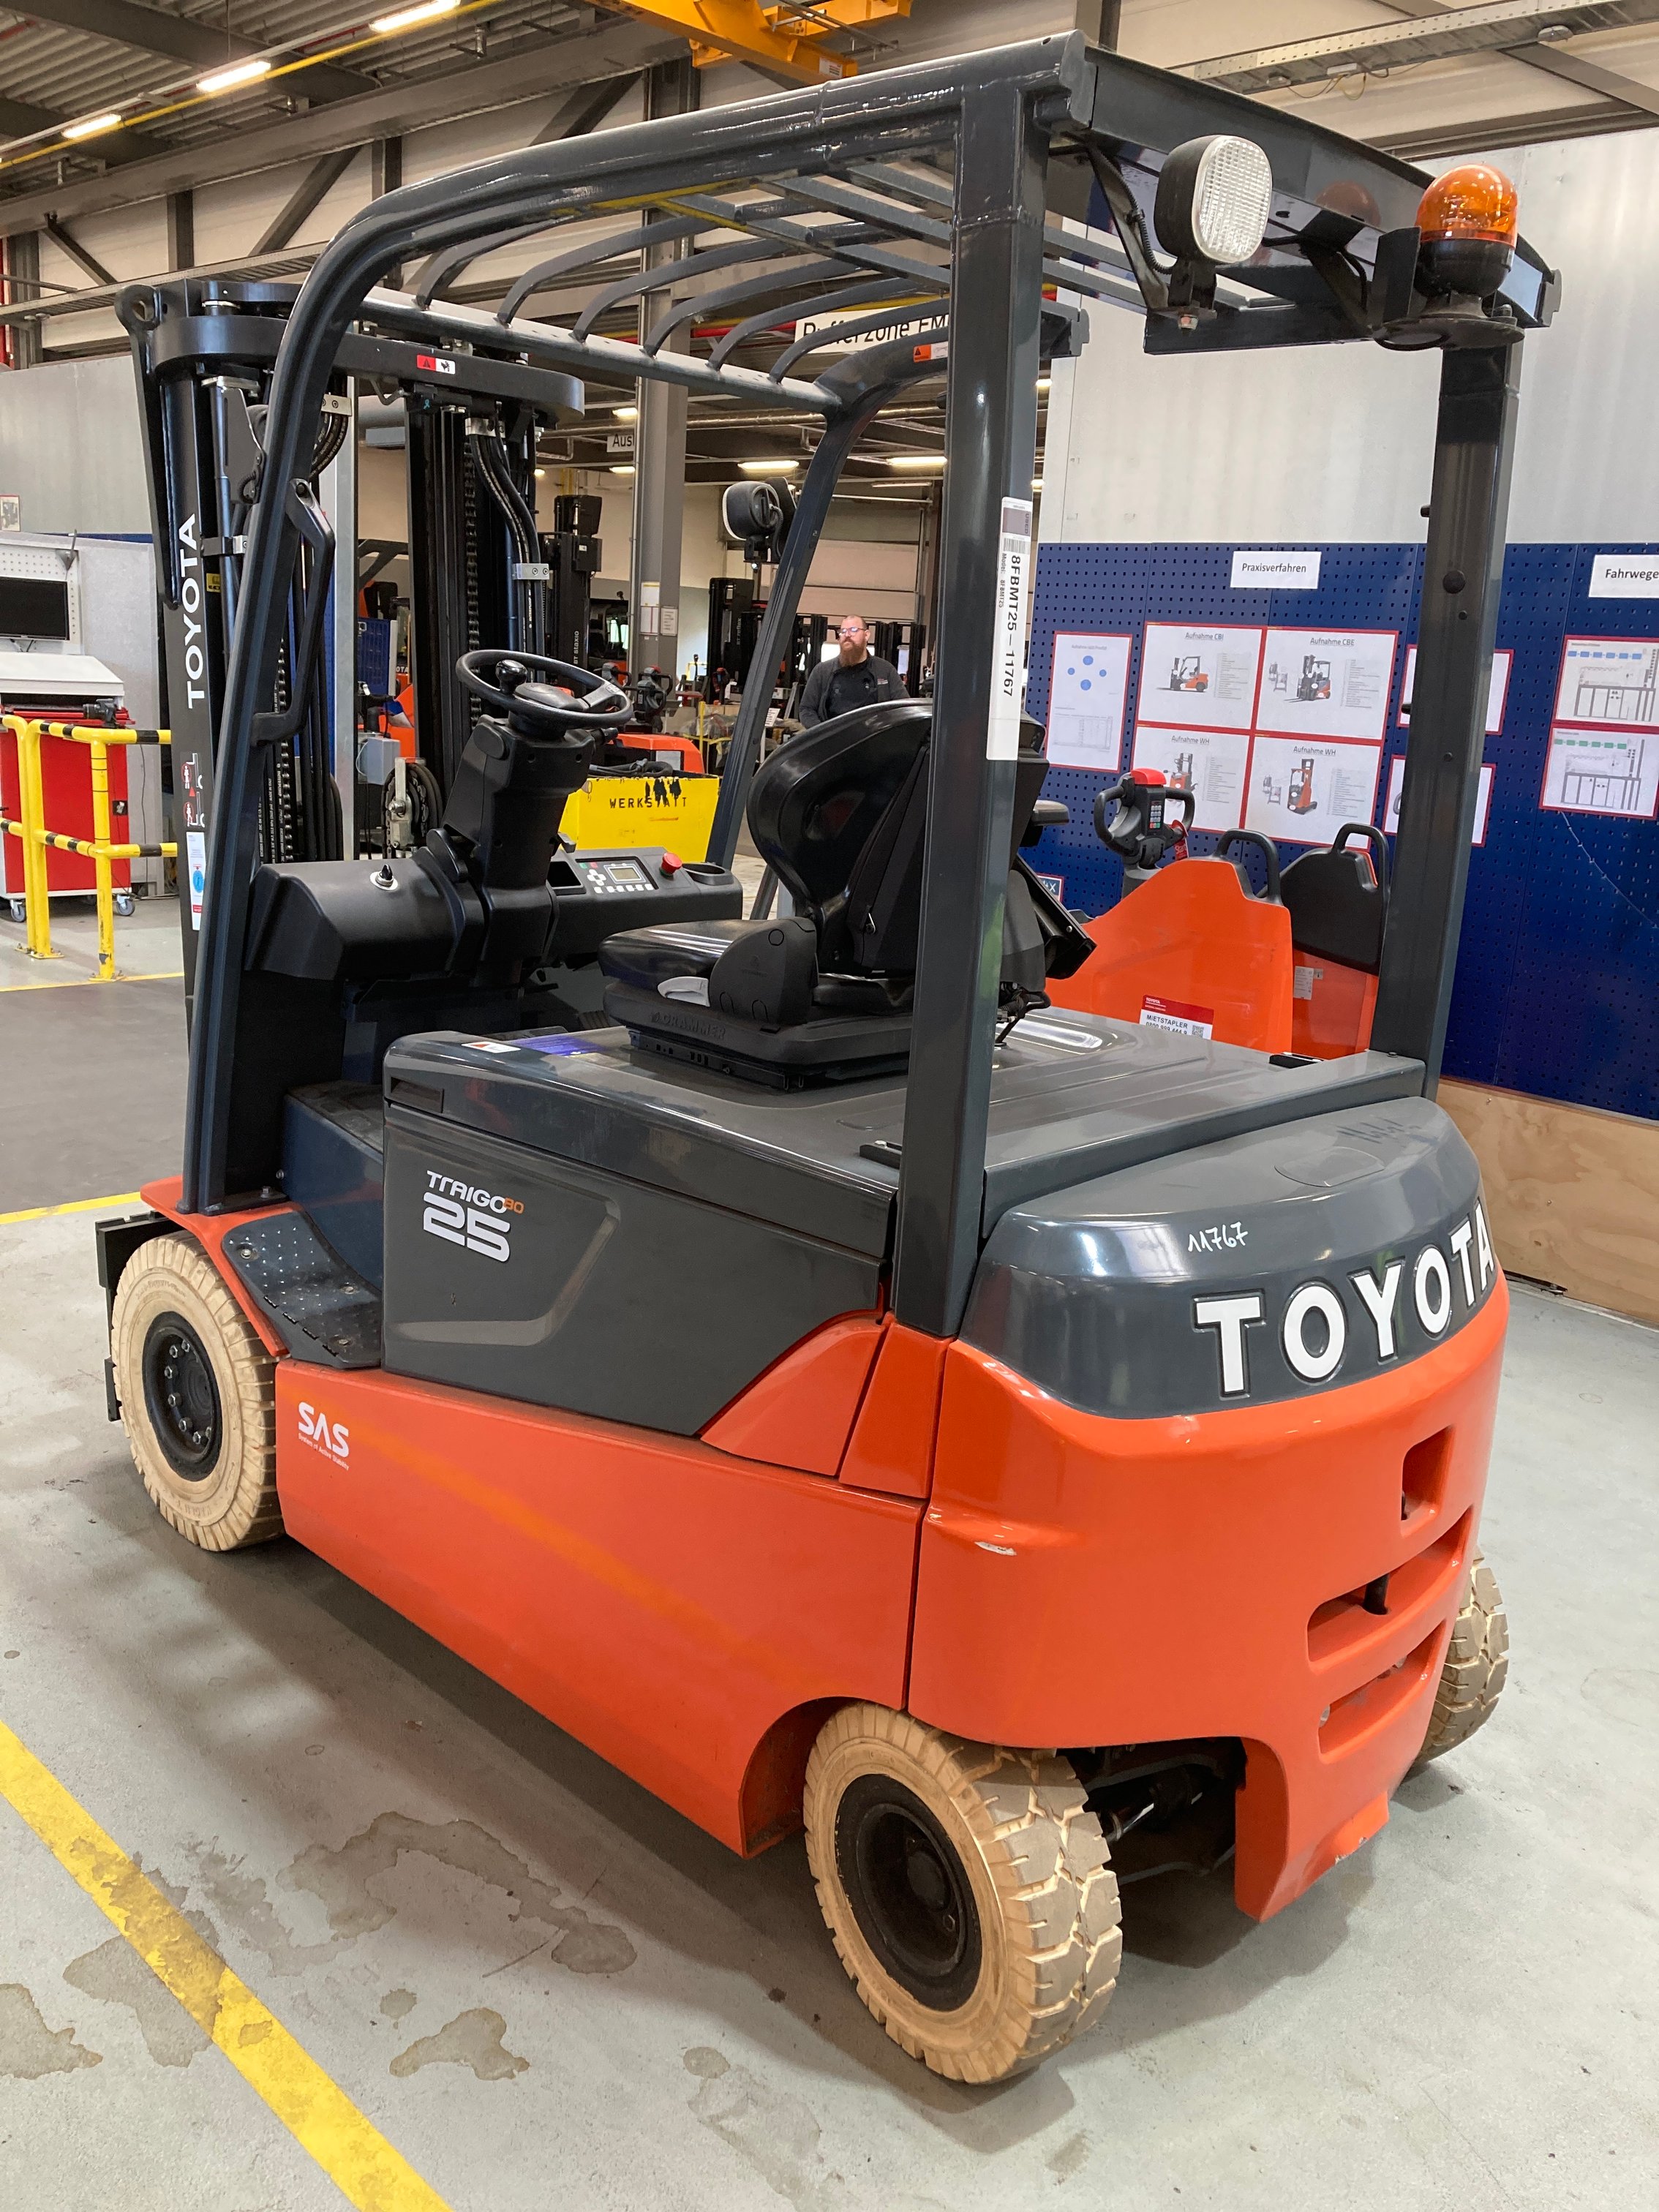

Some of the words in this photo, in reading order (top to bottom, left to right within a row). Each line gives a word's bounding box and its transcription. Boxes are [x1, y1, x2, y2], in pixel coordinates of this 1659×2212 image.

[1242, 563, 1306, 573] Praxisverfahren
[1605, 568, 1659, 581] Fahrwege
[178, 514, 205, 709] TOYOTA
[1185, 632, 1214, 640] Aufnahme
[1310, 637, 1342, 645] Aufnahme
[1171, 735, 1199, 744] Aufnahme
[1293, 745, 1324, 755] Aufnahme
[426, 1170, 508, 1214] TRAIGO
[423, 1192, 511, 1263] 25
[1187, 1221, 1249, 1252] 11767
[1196, 1200, 1494, 1393] TOYOTA
[298, 1402, 350, 1458] SAS
